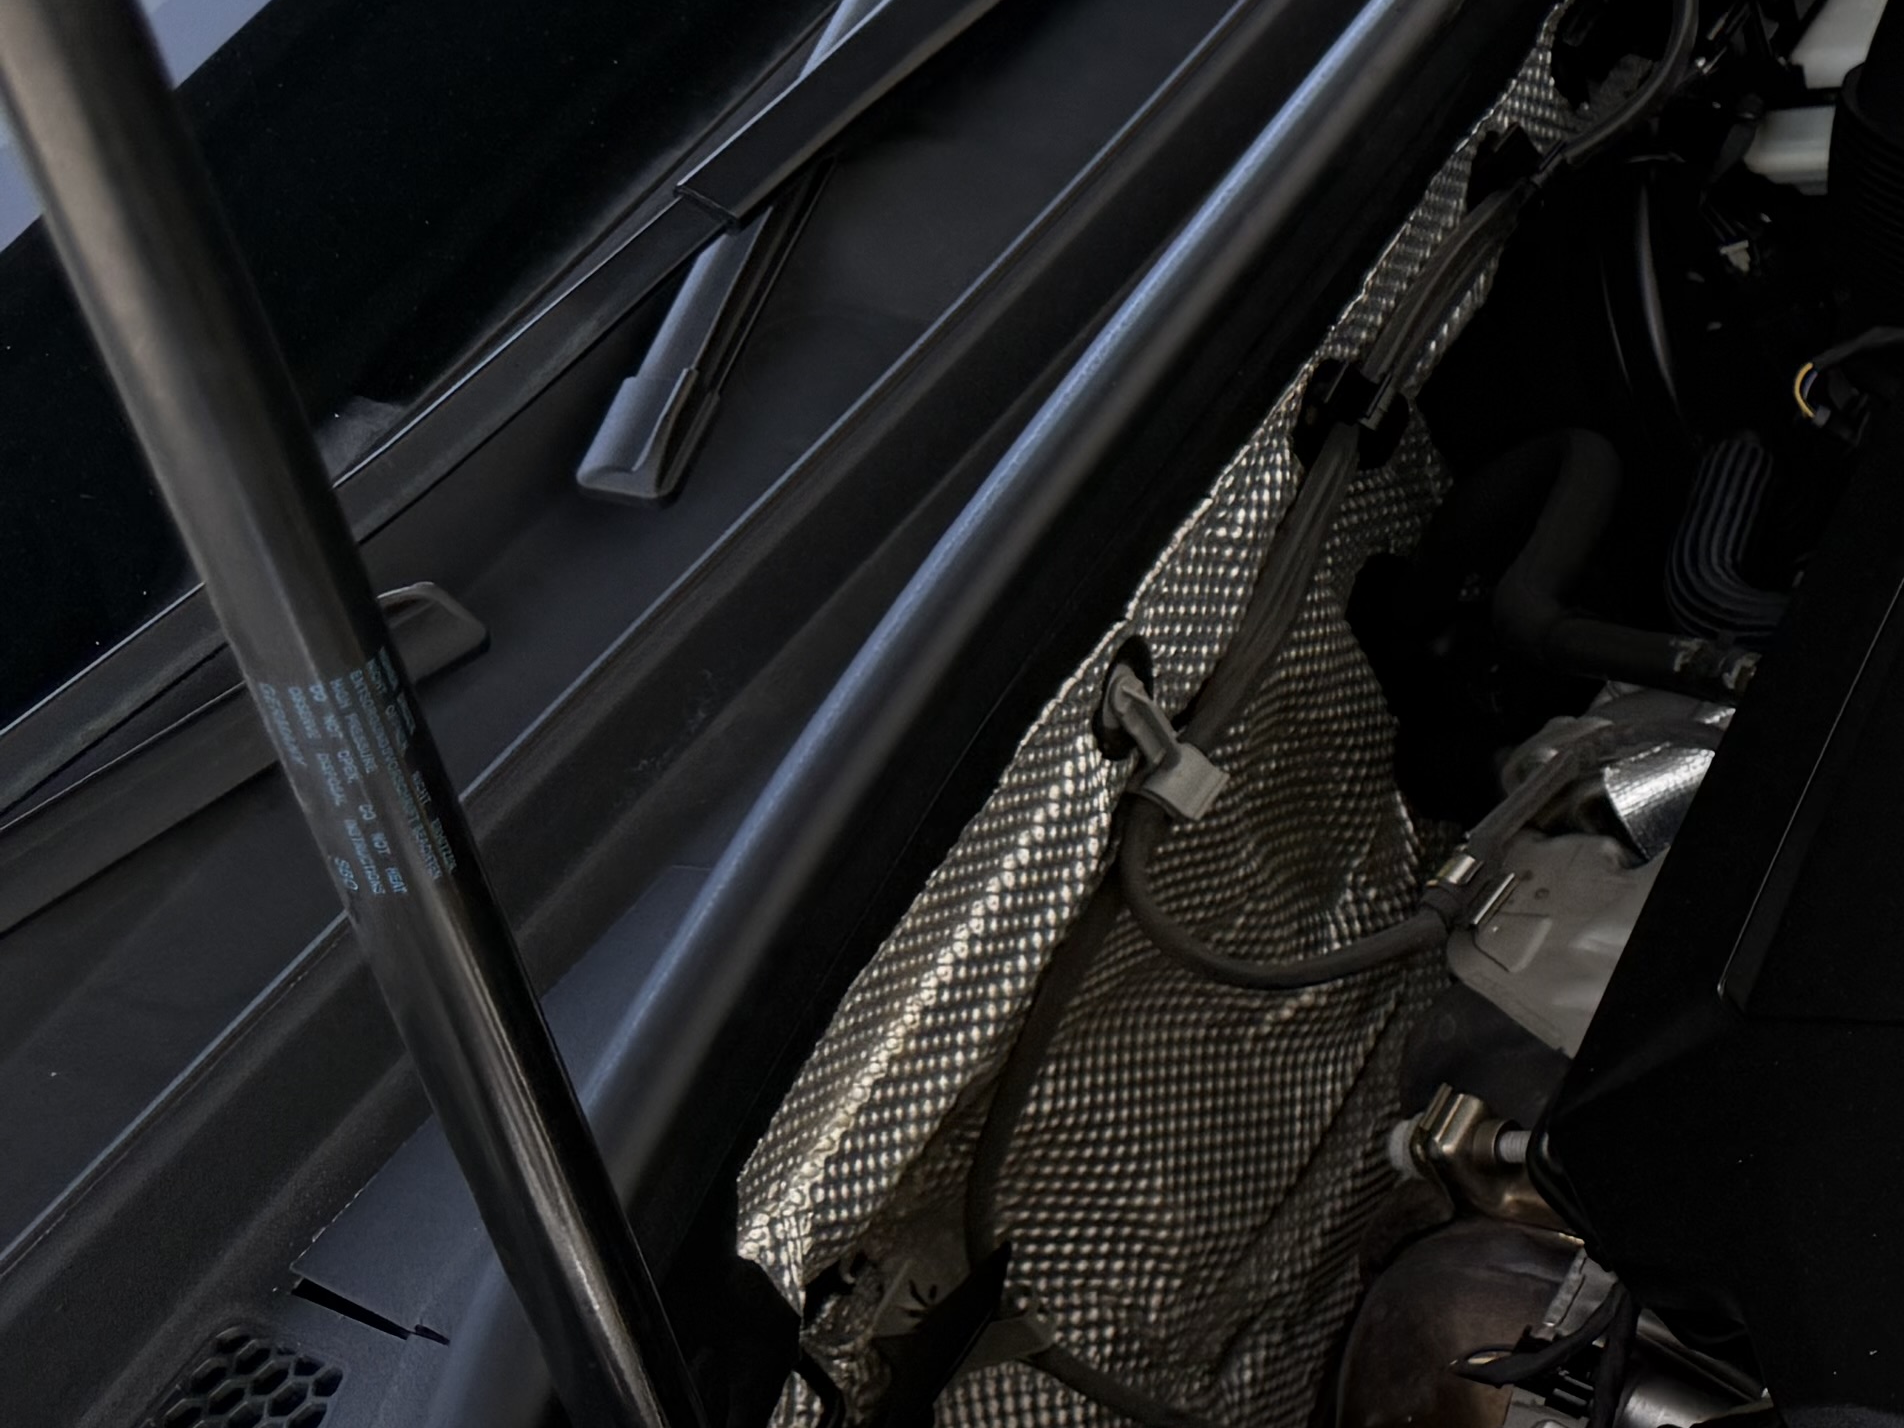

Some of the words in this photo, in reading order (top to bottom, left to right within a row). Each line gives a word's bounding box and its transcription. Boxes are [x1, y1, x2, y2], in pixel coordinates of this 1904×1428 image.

[307, 682, 329, 704] DO
[320, 713, 344, 742] NOT
[357, 801, 377, 821] DO
[368, 830, 392, 857] NOT
[383, 865, 407, 895] HEAT
[342, 712, 379, 774] PRESSURE
